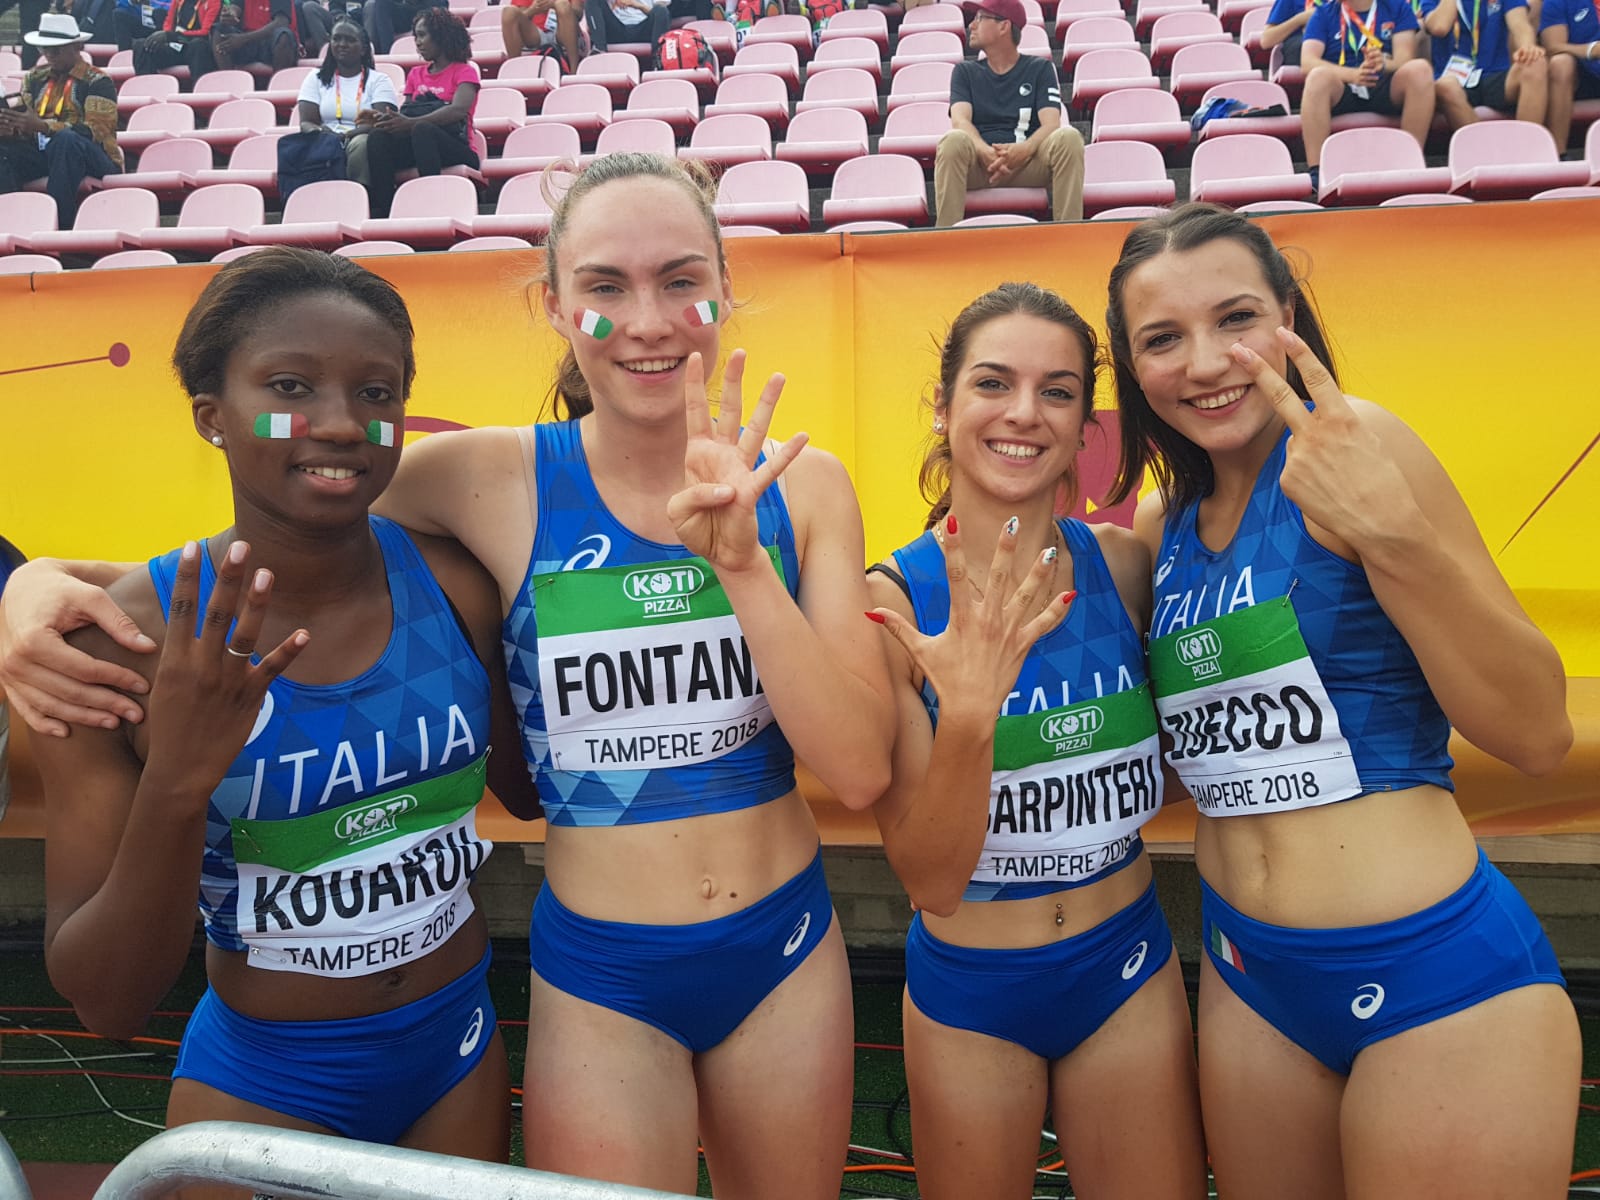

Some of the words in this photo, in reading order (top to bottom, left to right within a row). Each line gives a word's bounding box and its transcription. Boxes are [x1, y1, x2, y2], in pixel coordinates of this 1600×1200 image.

[632, 571, 695, 597] KOTI
[644, 598, 685, 614] PIZZA
[1180, 632, 1218, 661] KOTI
[554, 635, 765, 717] FONTAN
[1192, 661, 1218, 677] PIZZA
[584, 732, 704, 764] TAMPERE
[711, 718, 759, 753] 2018
[1048, 710, 1097, 738] KOTI
[1164, 685, 1323, 761] ZUECCO
[247, 703, 477, 820] ITALIA
[1056, 735, 1090, 752] PIZZA
[986, 755, 1157, 835] ARPINTERI
[1190, 780, 1259, 808] TAMPERE
[1260, 771, 1320, 804] 2018
[253, 825, 485, 933] KOUAKOU
[991, 851, 1095, 877] TAMPERE
[284, 931, 414, 971] TAMPERE
[421, 901, 457, 950] 2018
